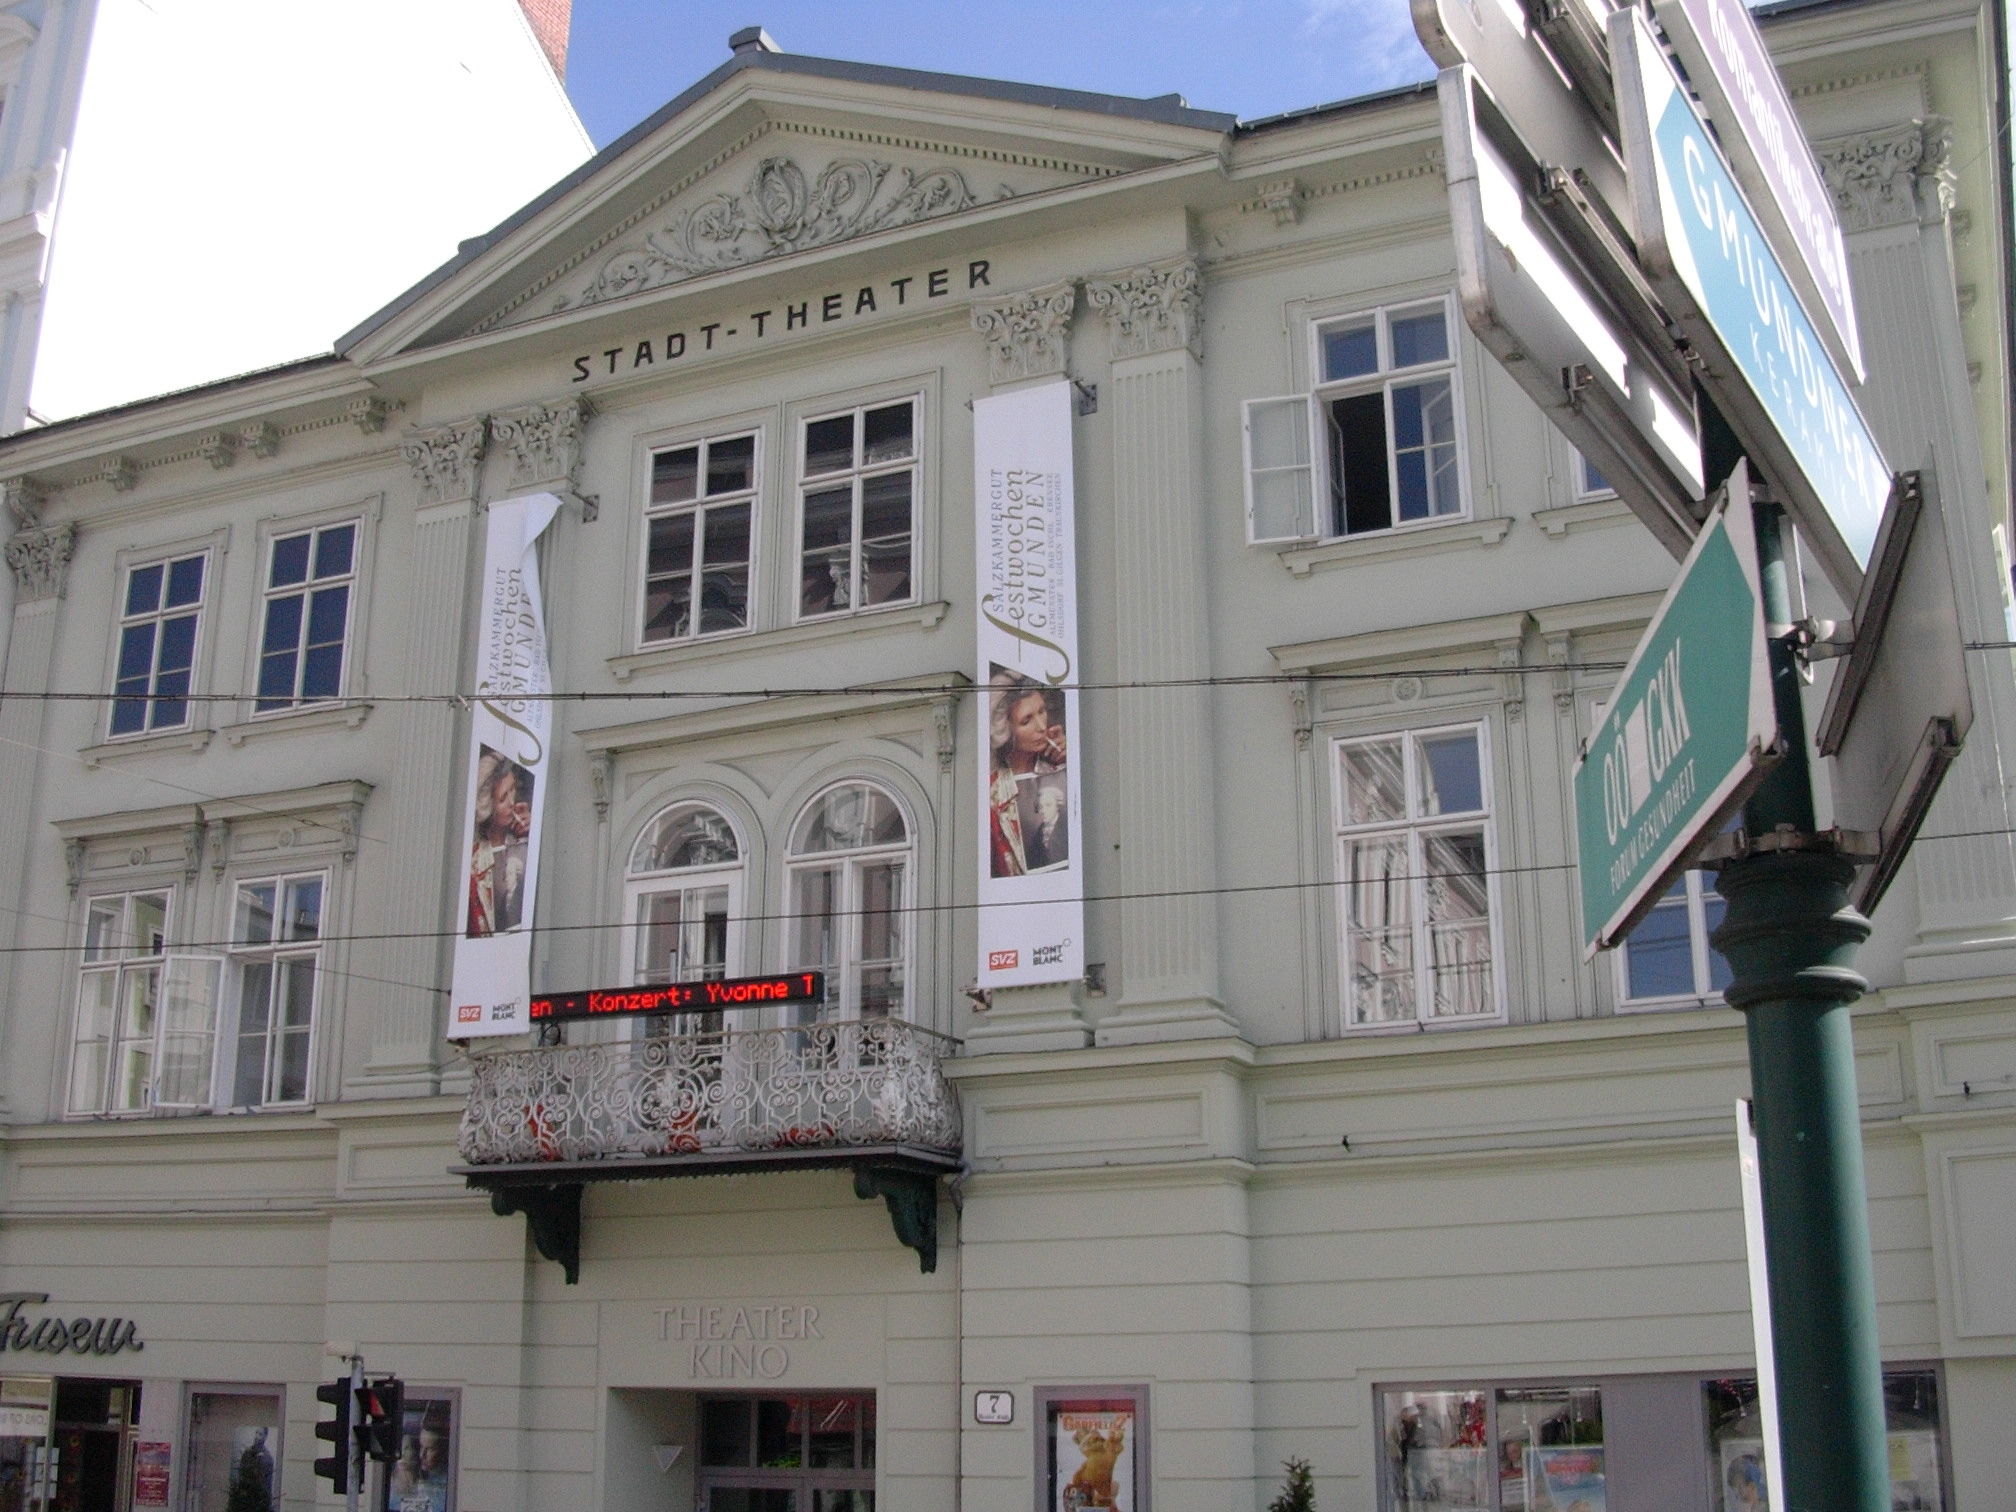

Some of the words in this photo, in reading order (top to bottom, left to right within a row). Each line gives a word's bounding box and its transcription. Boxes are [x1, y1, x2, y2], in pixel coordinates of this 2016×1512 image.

[572, 259, 991, 383] STADT-THEATER
[1683, 135, 1874, 511] GMUNDNER
[990, 468, 1004, 613] SALZKAMMERGUT
[1026, 470, 1047, 629] GMUNDEN
[1637, 757, 1697, 859] GESUNDHEIT
[588, 987, 692, 1013] Konzert:
[706, 980, 788, 1003] Yvonne
[653, 1304, 826, 1341] THEATER
[689, 1343, 790, 1380] KINO
[989, 1394, 1000, 1413] 7
